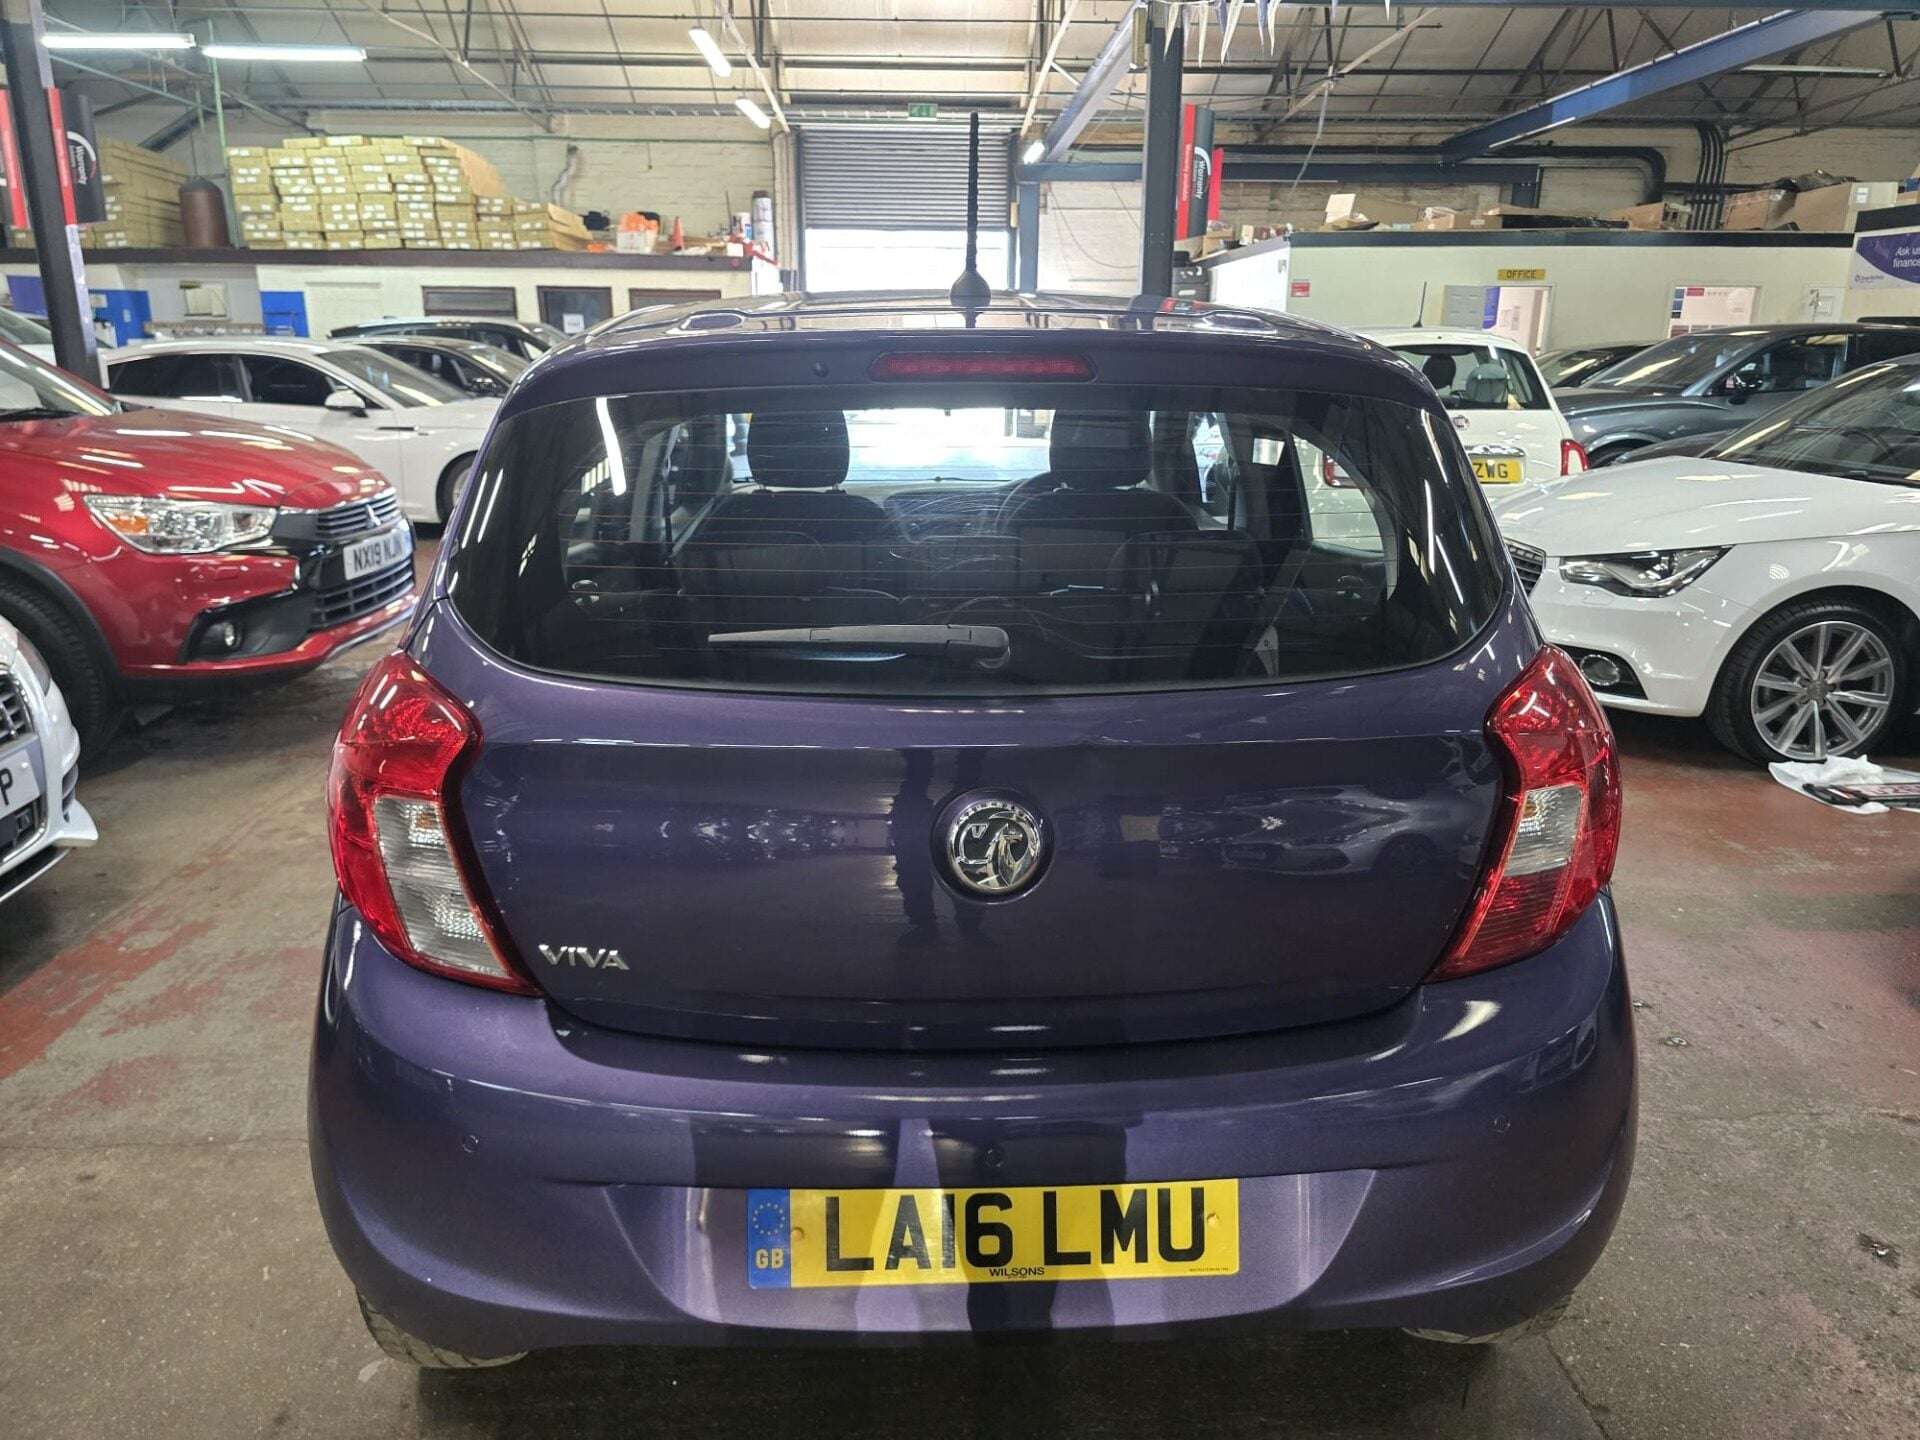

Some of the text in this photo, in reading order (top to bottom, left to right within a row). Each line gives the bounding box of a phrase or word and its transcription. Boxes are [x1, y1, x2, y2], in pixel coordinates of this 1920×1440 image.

[1195, 160, 1205, 199] Warranty
[1895, 245, 1911, 257] Ask
[1506, 270, 1537, 280] OFFICE
[1472, 462, 1509, 479] ZWG
[353, 541, 383, 573] NX19
[538, 944, 630, 971] VIVA
[825, 1187, 1205, 1272] LA16 LMU
[755, 1247, 785, 1270] GB
[989, 1265, 1045, 1278] WILSONS
